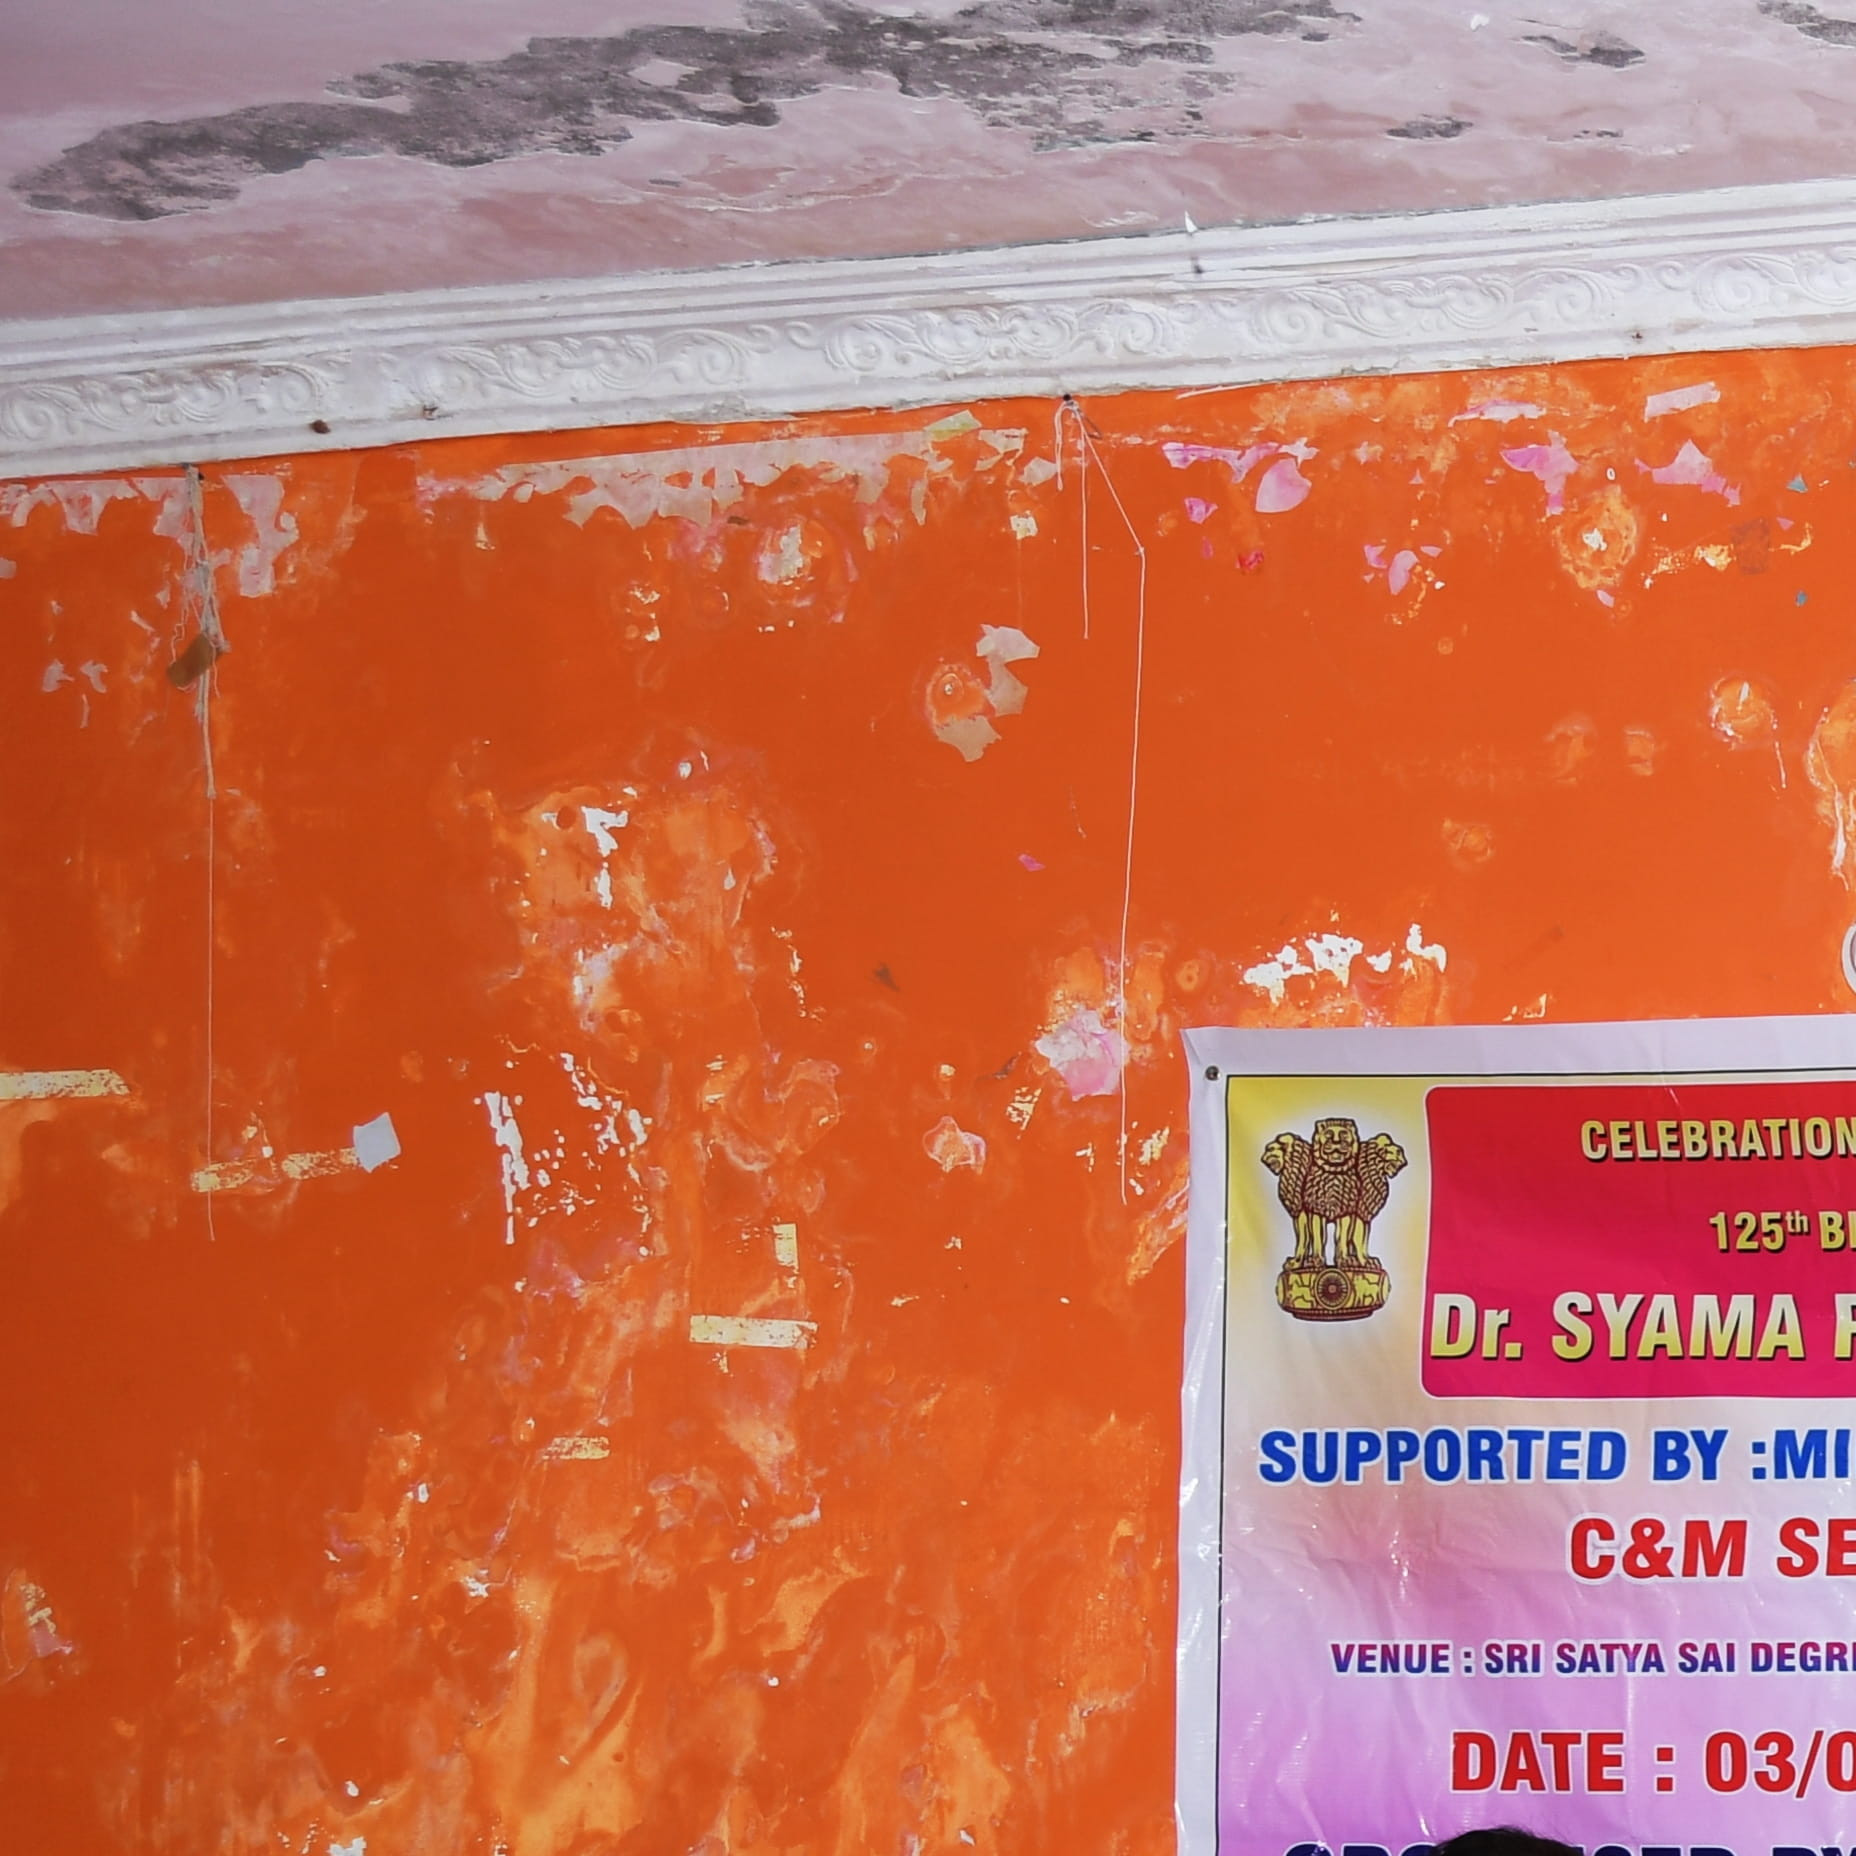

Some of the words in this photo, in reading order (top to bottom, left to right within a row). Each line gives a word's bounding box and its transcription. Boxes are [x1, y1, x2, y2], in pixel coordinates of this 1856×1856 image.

[1709, 1208, 1810, 1253] 125th
[1430, 1293, 1523, 1360] Dr.
[1551, 1291, 1806, 1361] SYAMA
[1258, 1427, 1628, 1486] SUPPORTED
[1652, 1427, 1730, 1483] BY
[1570, 1516, 1748, 1579] C&M
[1331, 1643, 1451, 1675] VENUE
[1484, 1642, 1542, 1674] SRI
[1555, 1642, 1666, 1674] SATYA
[1677, 1642, 1738, 1674] SAI
[1451, 1731, 1626, 1793] DATE
